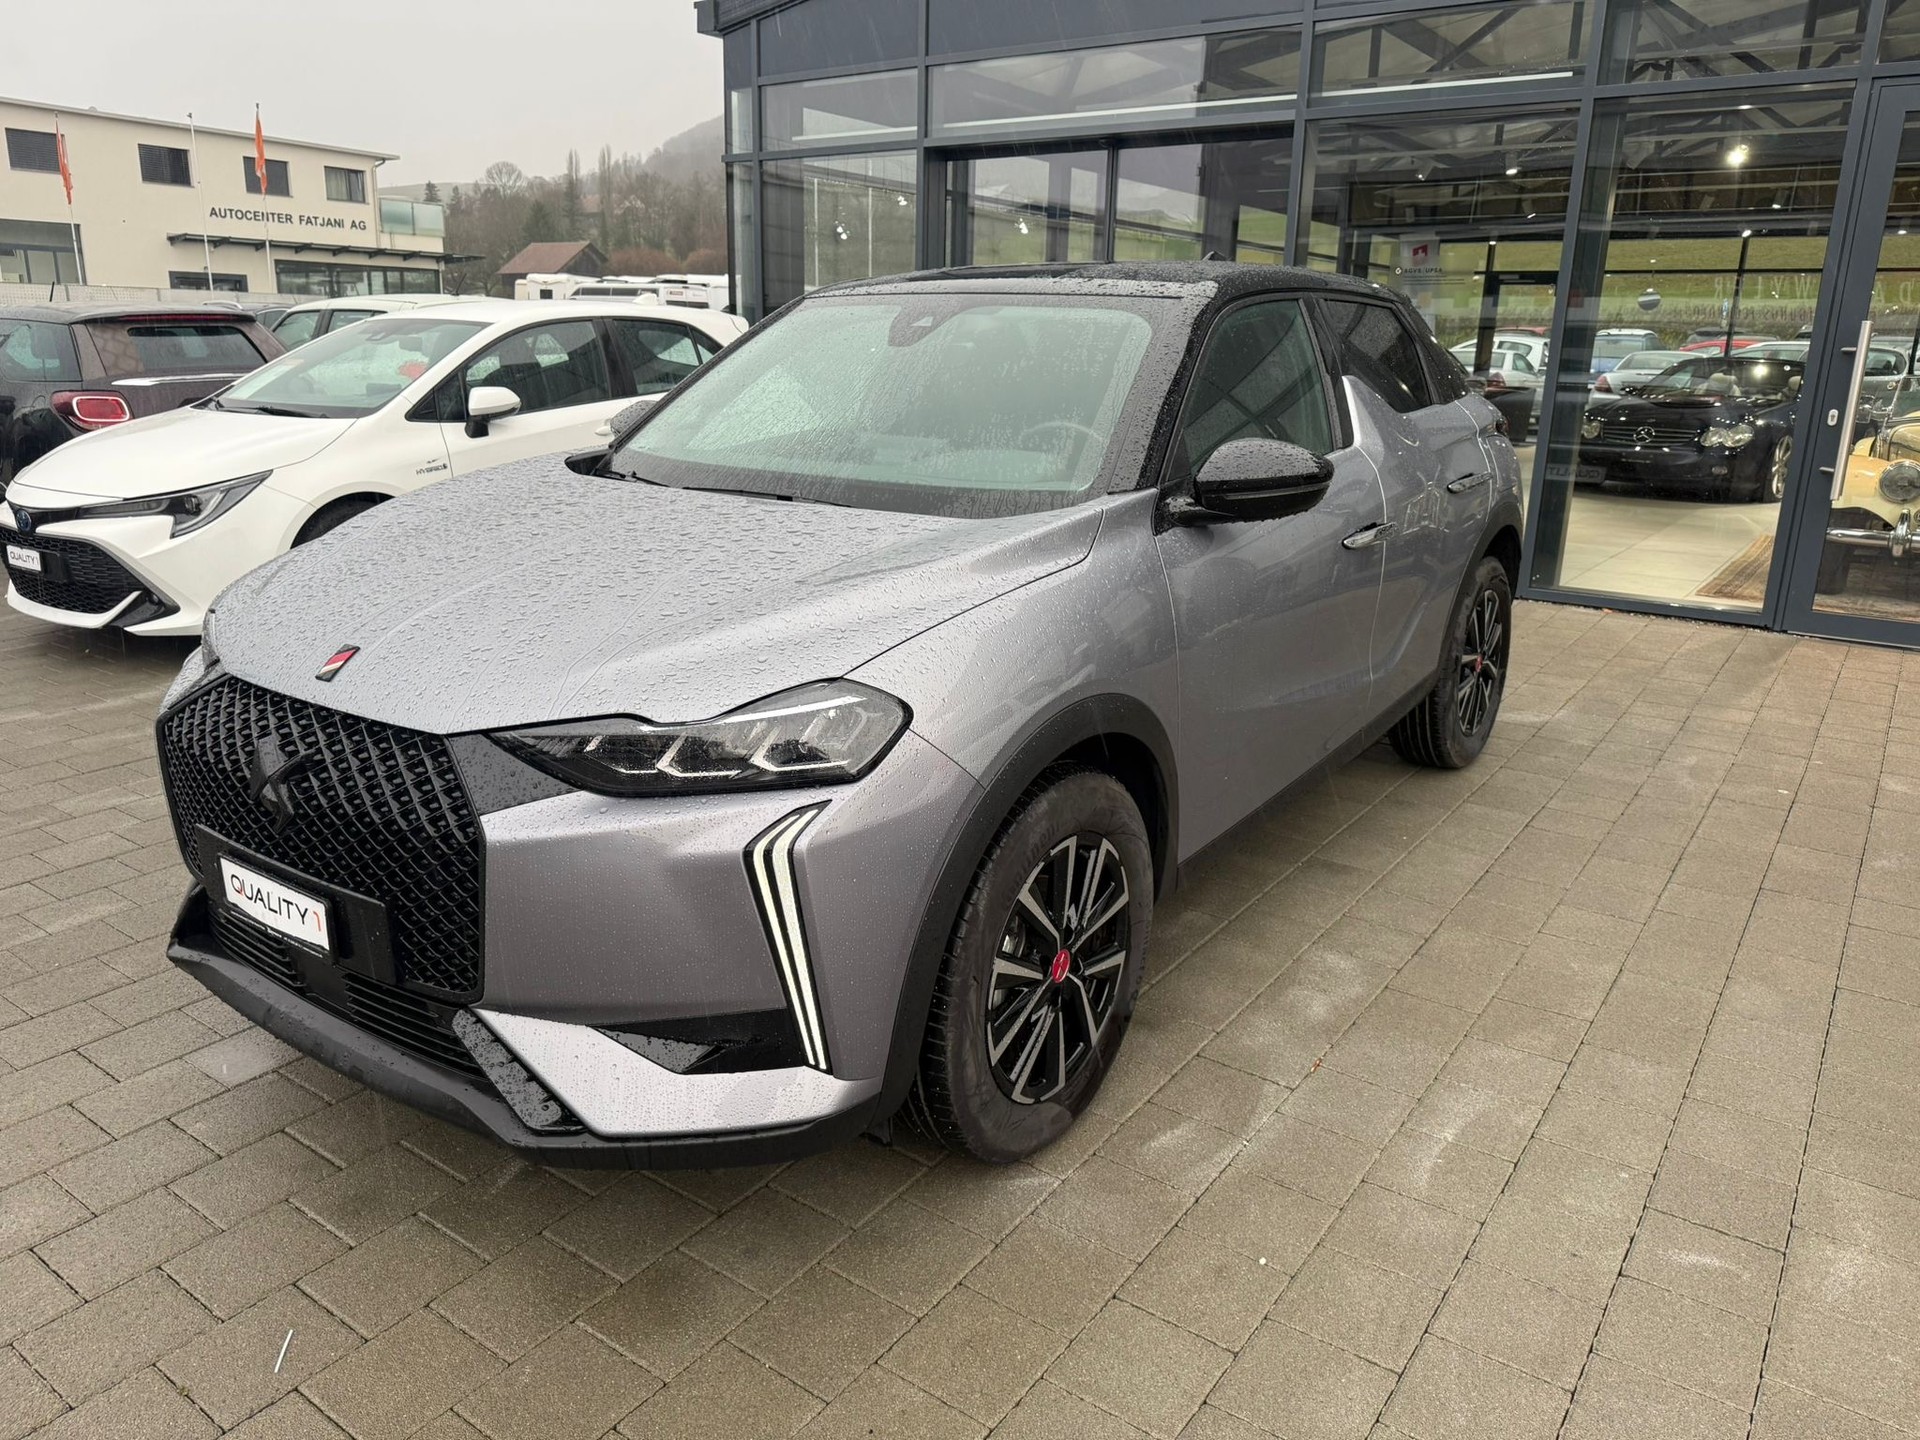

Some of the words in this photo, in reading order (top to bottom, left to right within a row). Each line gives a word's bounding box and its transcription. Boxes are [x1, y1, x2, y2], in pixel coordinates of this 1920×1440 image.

[209, 207, 294, 225] AUTOCENTER
[299, 215, 345, 229] FATJANI
[350, 220, 367, 231] AG
[10, 551, 35, 565] QUALITY
[230, 873, 309, 926] QUALITY
[312, 910, 322, 932] 1
